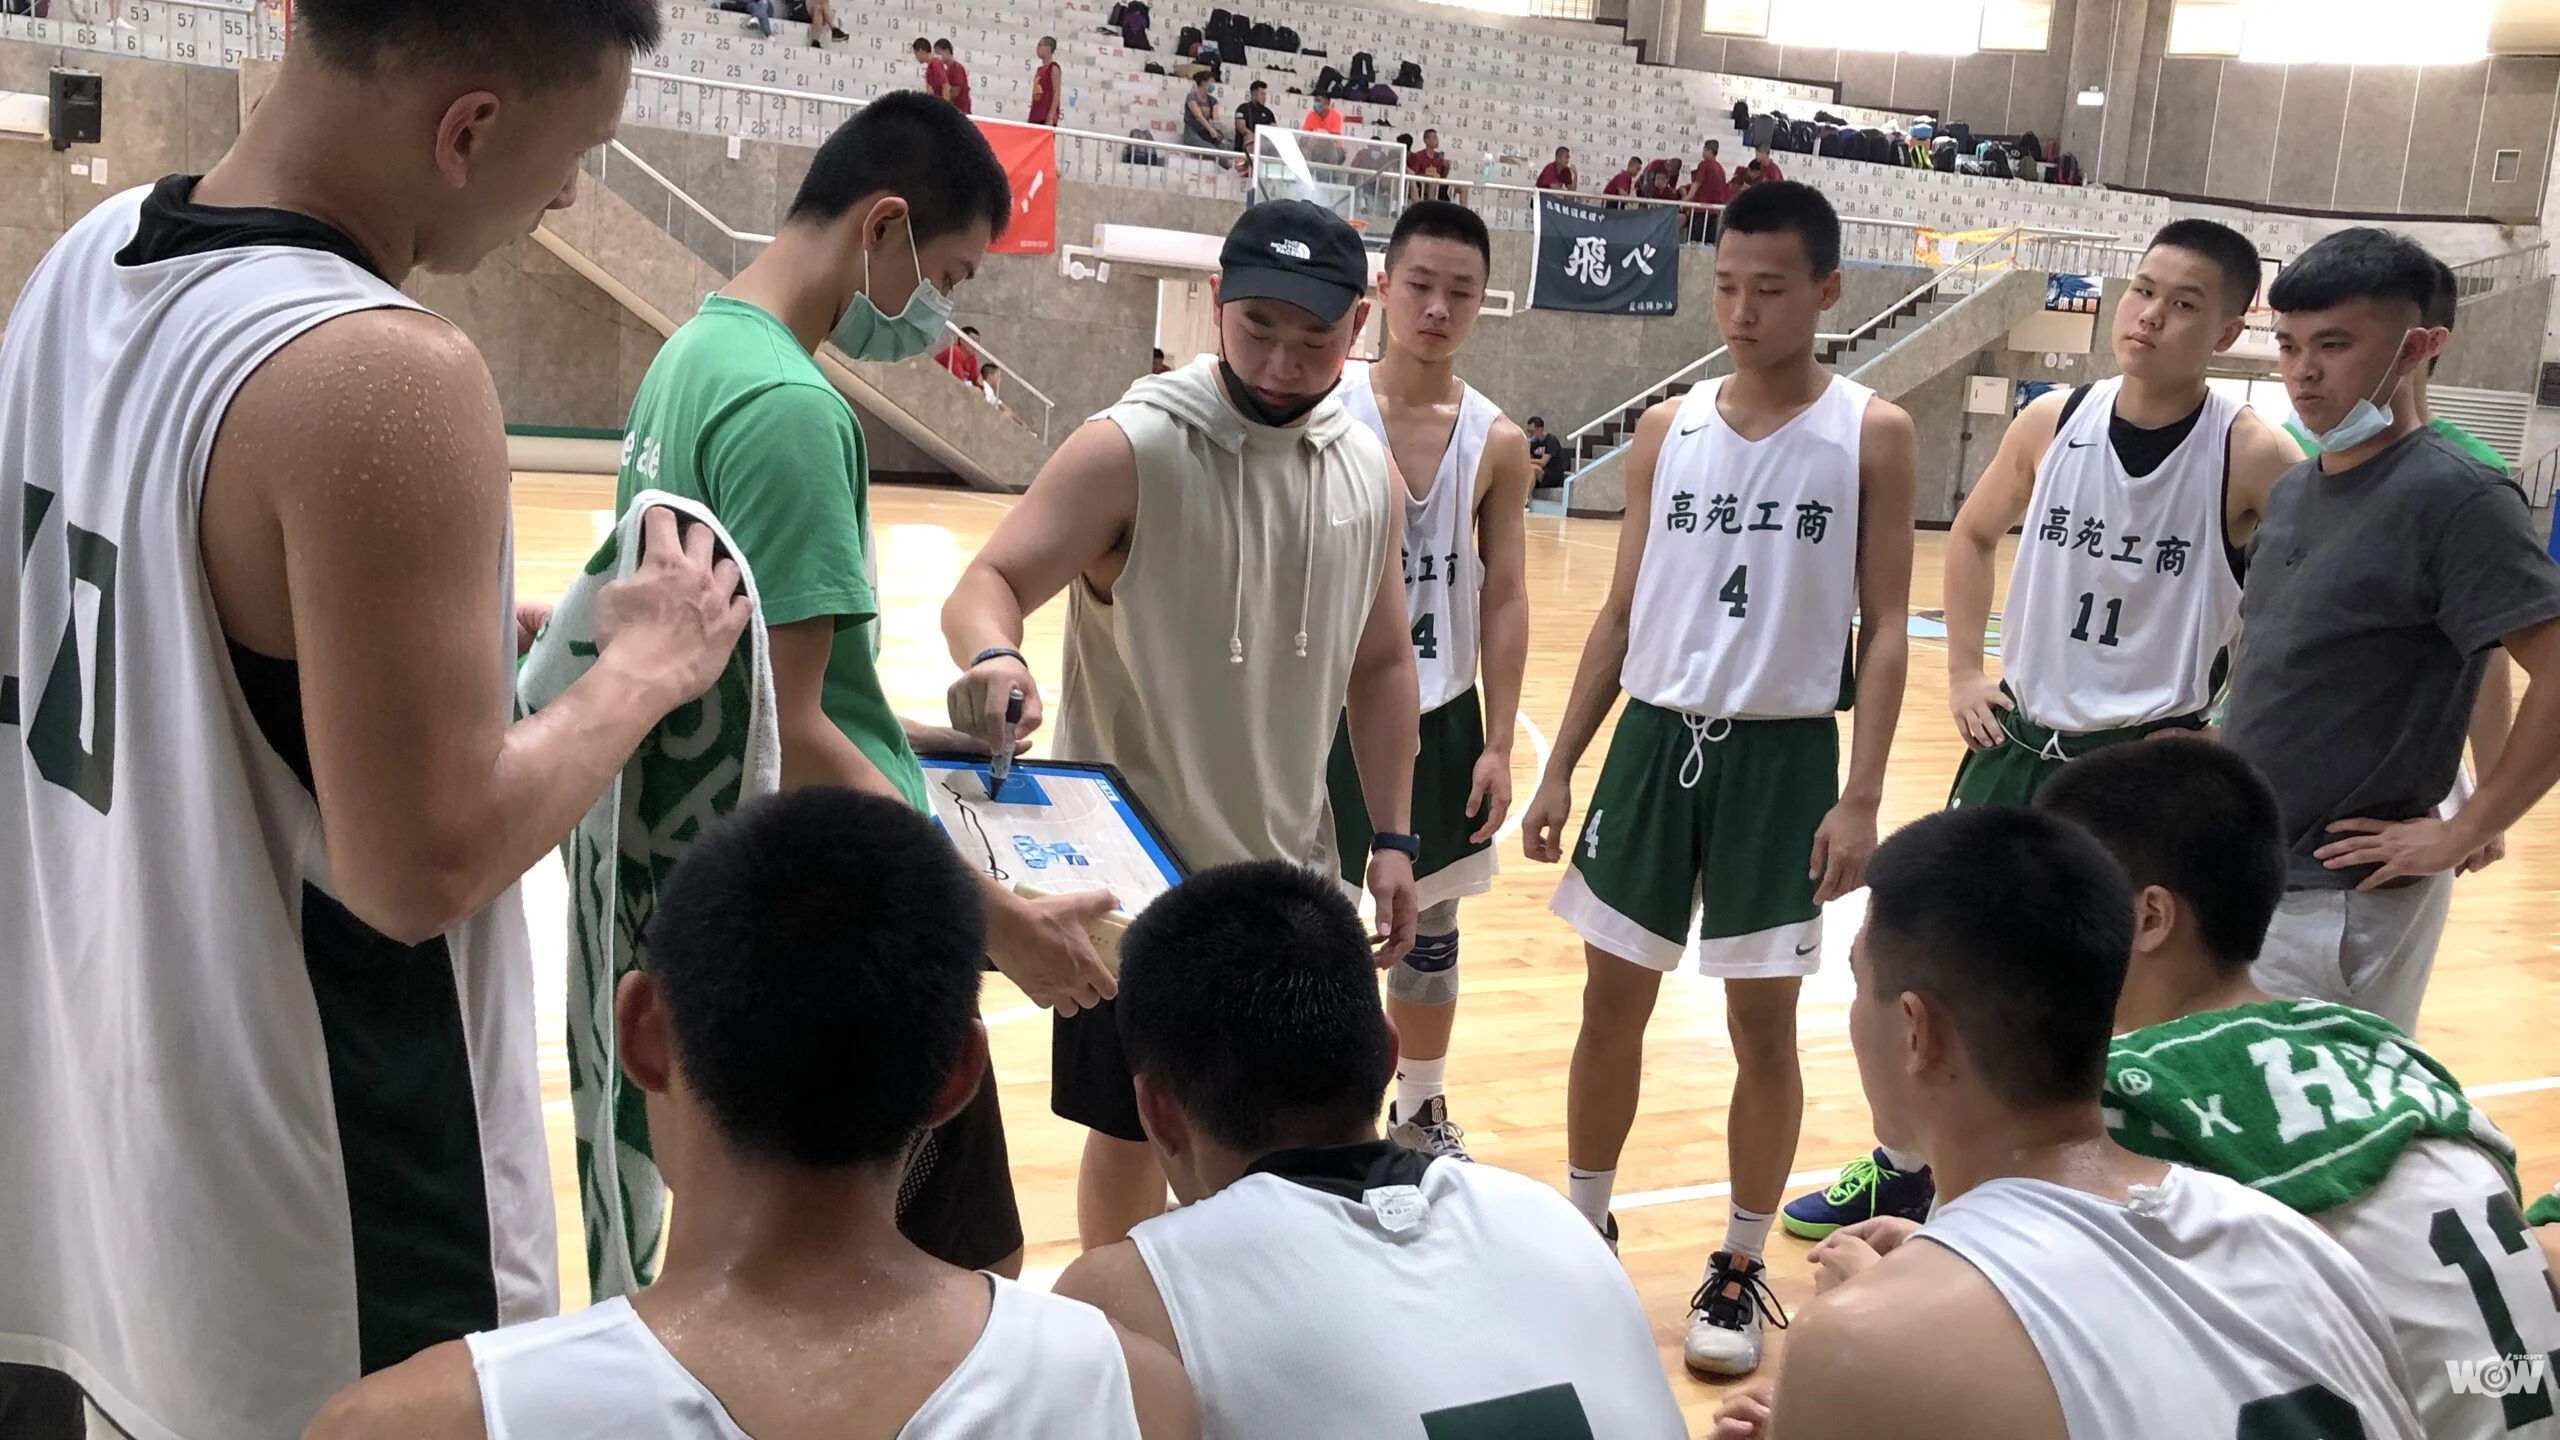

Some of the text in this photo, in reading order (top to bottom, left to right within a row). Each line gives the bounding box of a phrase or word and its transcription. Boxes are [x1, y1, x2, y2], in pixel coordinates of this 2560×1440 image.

[178, 13, 195, 28] 57
[672, 7, 719, 24] 27 25
[905, 1, 914, 10] 11
[936, 4, 942, 14] 9
[967, 8, 971, 19] 7
[995, 13, 1000, 23] 5
[1024, 17, 1029, 27] 3
[1304, 6, 1362, 21] 20 22 24
[225, 20, 243, 35] 55
[857, 14, 1015, 45] 15 13 11 9 7 5
[871, 37, 881, 49] 15
[1372, 33, 1381, 42] 24
[177, 42, 195, 58] 59
[1565, 41, 1573, 50] 42
[225, 49, 242, 63] 57
[682, 33, 896, 74] 27 25 23 21 19 17 15
[1257, 52, 1267, 62] 12
[1025, 60, 1031, 71] 5
[1563, 60, 1618, 74] 40 42 44
[655, 55, 877, 96] 29 27 25 23 21 19 17
[663, 82, 714, 99] 29 27
[981, 77, 1017, 91] 9 7
[1163, 79, 1168, 91] 2
[1586, 78, 1641, 94] 40 42 44
[1271, 95, 1307, 109] 10 12
[1408, 93, 1444, 105] 22 24
[1535, 91, 1544, 100] 34
[996, 102, 1002, 113] 9
[1583, 97, 1616, 109] 38 40
[677, 111, 728, 129] 29 27
[1089, 113, 1095, 124] 3
[1405, 112, 1467, 127] 20 22 24
[1558, 112, 1568, 121] 34
[1508, 123, 1592, 143] 28 30 32 34
[1631, 121, 1689, 136] 40 42 44
[1452, 138, 1488, 151] 22 24
[1656, 142, 1691, 154] 40 42
[1065, 161, 1070, 172] 7
[1605, 157, 1615, 167] 34
[1779, 155, 1812, 167] 52 54
[1501, 167, 1512, 176] 24
[1873, 167, 1928, 182] 60 62 64
[1579, 175, 1590, 185] 30
[1836, 182, 1938, 202] 56 58 60 62 64
[1988, 181, 2065, 198] 70 72 74 76
[2101, 193, 2155, 207] 80 82 84
[1846, 202, 1950, 223] 56 58 60 62 64
[2000, 201, 2078, 219] 70 72 74 76
[2118, 214, 2153, 224] 80 82
[2243, 223, 2279, 234] 90 92
[2133, 233, 2143, 243] 80
[2260, 243, 2297, 254] 90 92
[1666, 491, 1834, 545] 高苑工商
[2040, 506, 2191, 577] 高苑工商
[1719, 565, 1748, 618] 4
[2070, 592, 2123, 647] 11
[1411, 613, 1437, 659] 4
[1583, 809, 1604, 859] 4
